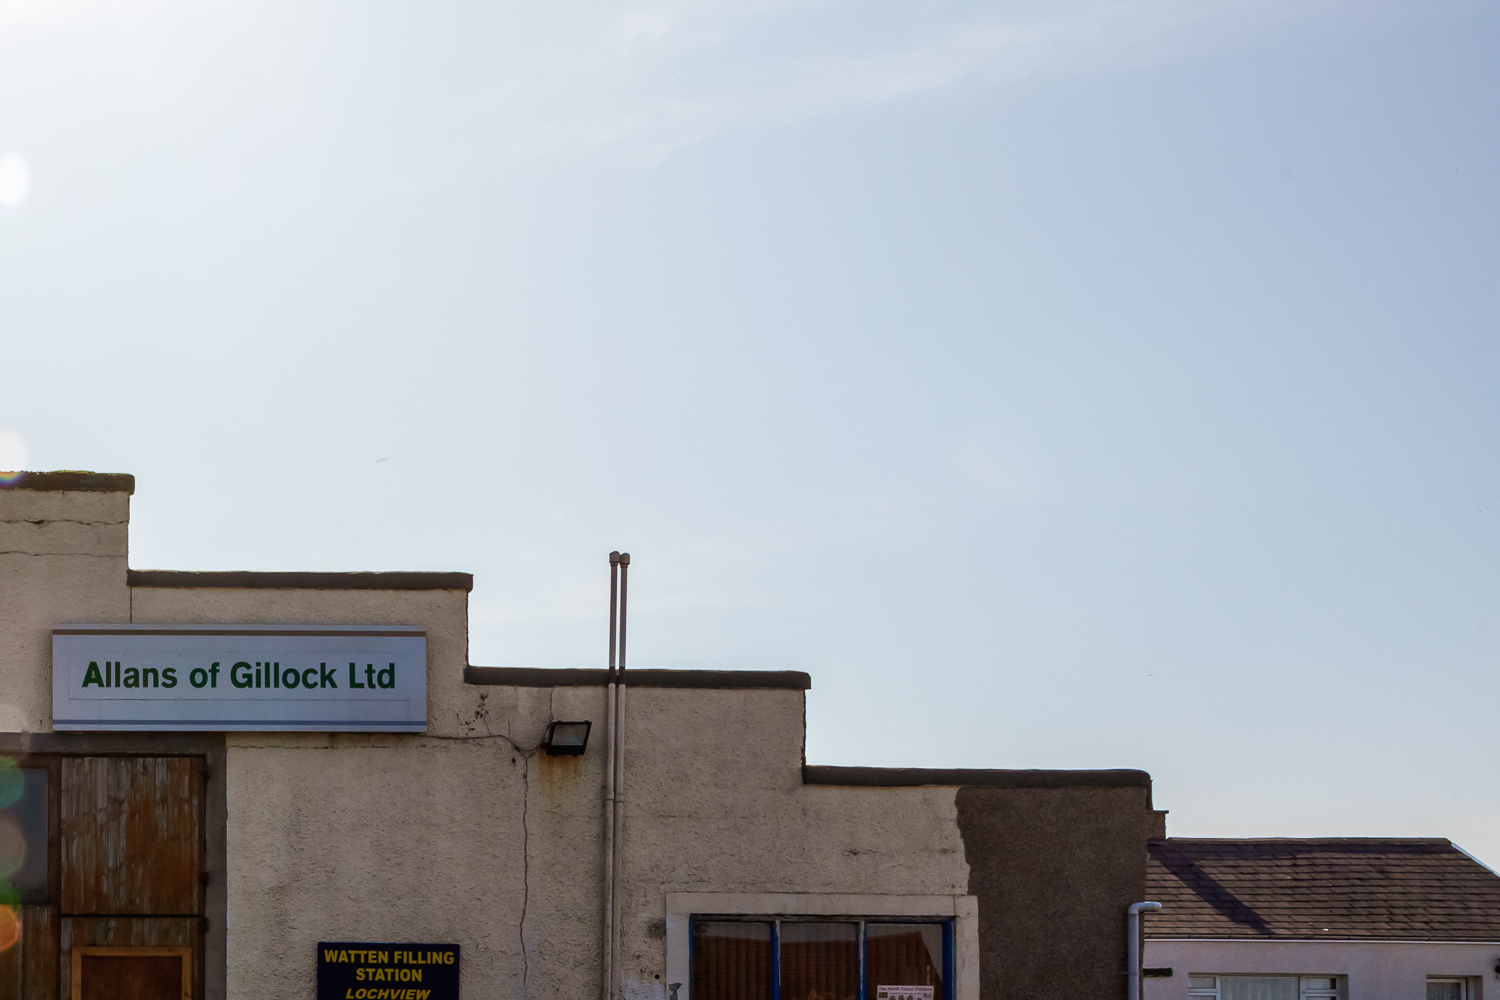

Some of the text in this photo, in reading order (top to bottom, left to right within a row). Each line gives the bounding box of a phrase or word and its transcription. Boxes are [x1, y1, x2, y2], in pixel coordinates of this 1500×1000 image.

[82, 662, 395, 689] Allans of Gillock Ltd
[325, 950, 454, 964] WATTEN FILLING
[356, 968, 422, 981] STATION
[346, 988, 430, 1000] LOCHVIEW
